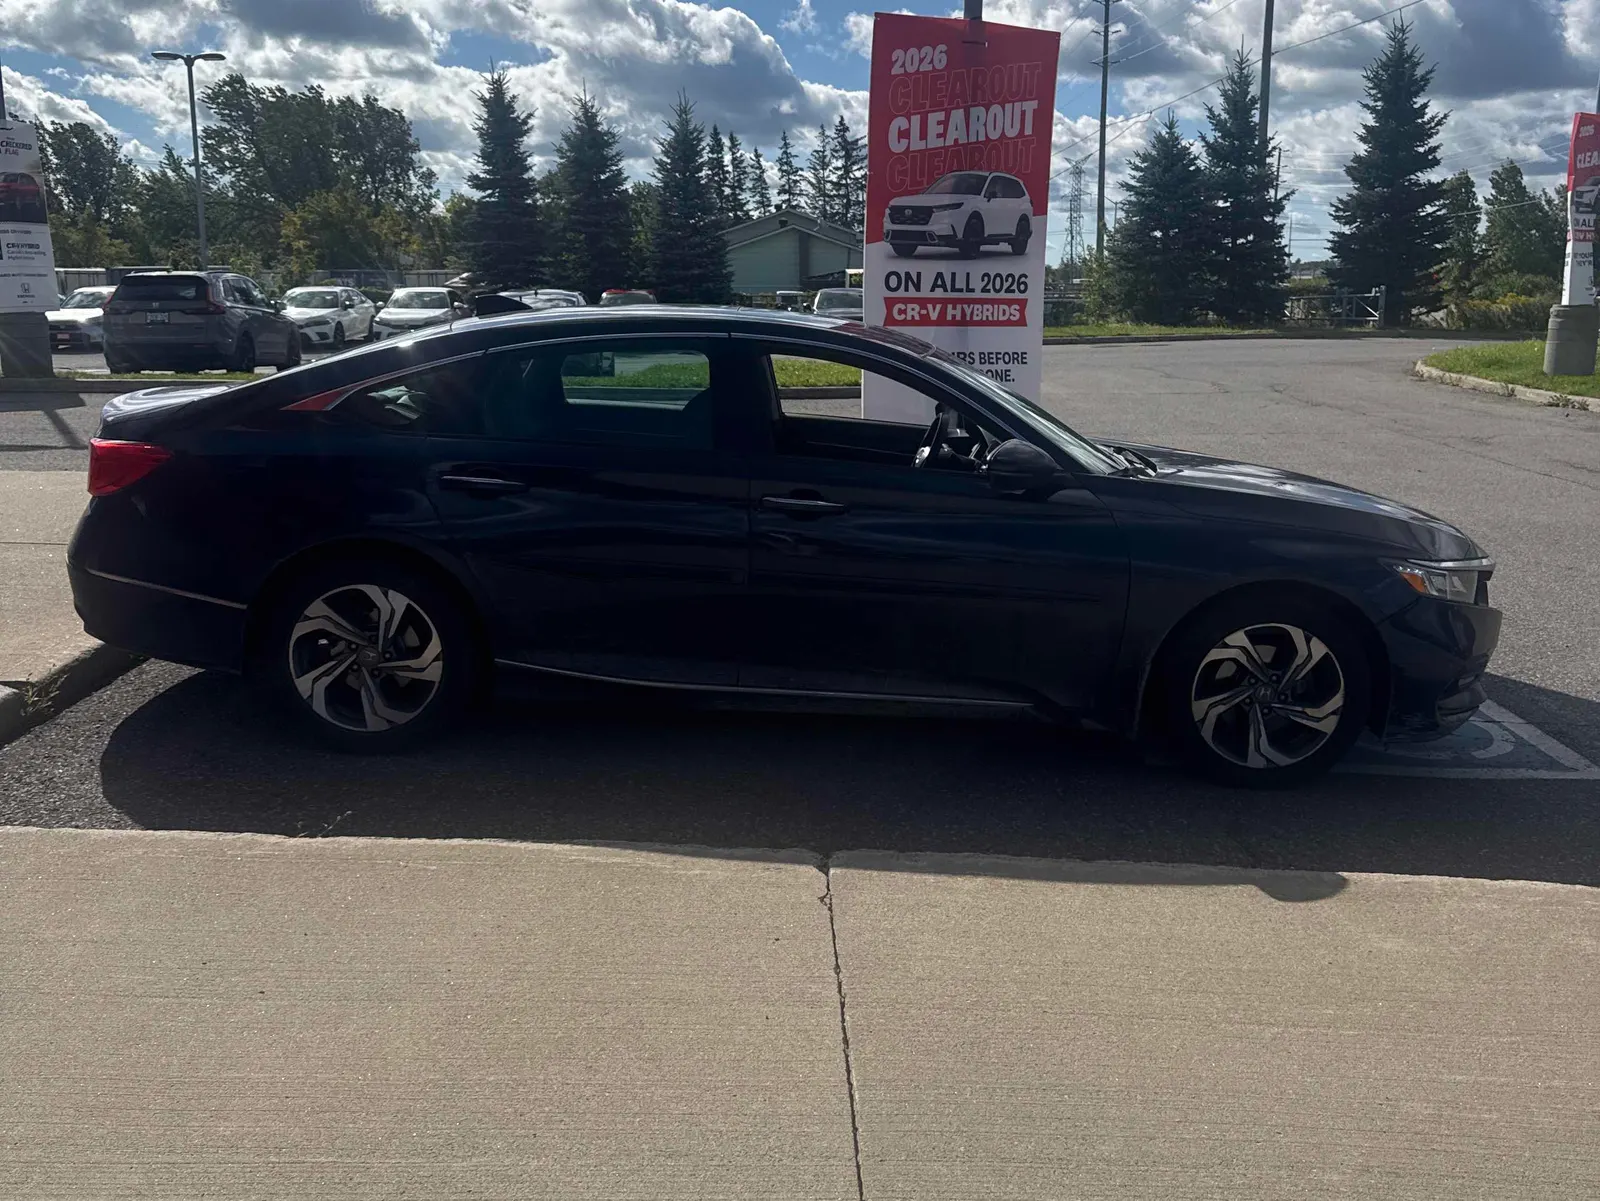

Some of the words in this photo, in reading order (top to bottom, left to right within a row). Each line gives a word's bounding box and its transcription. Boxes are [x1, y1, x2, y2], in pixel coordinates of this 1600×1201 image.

[891, 44, 947, 75] 2026
[889, 62, 1042, 115] CLEAROUT
[888, 100, 1038, 153] CLEAROUT
[1576, 151, 1600, 169] CLEA
[884, 271, 922, 293] ON
[929, 272, 976, 293] ALL
[980, 273, 1029, 294] 2026
[892, 303, 943, 321] CR-V
[946, 303, 1020, 321] HYBRIDS
[978, 351, 1028, 365] BEFORE
[980, 368, 1015, 382] ONE.
